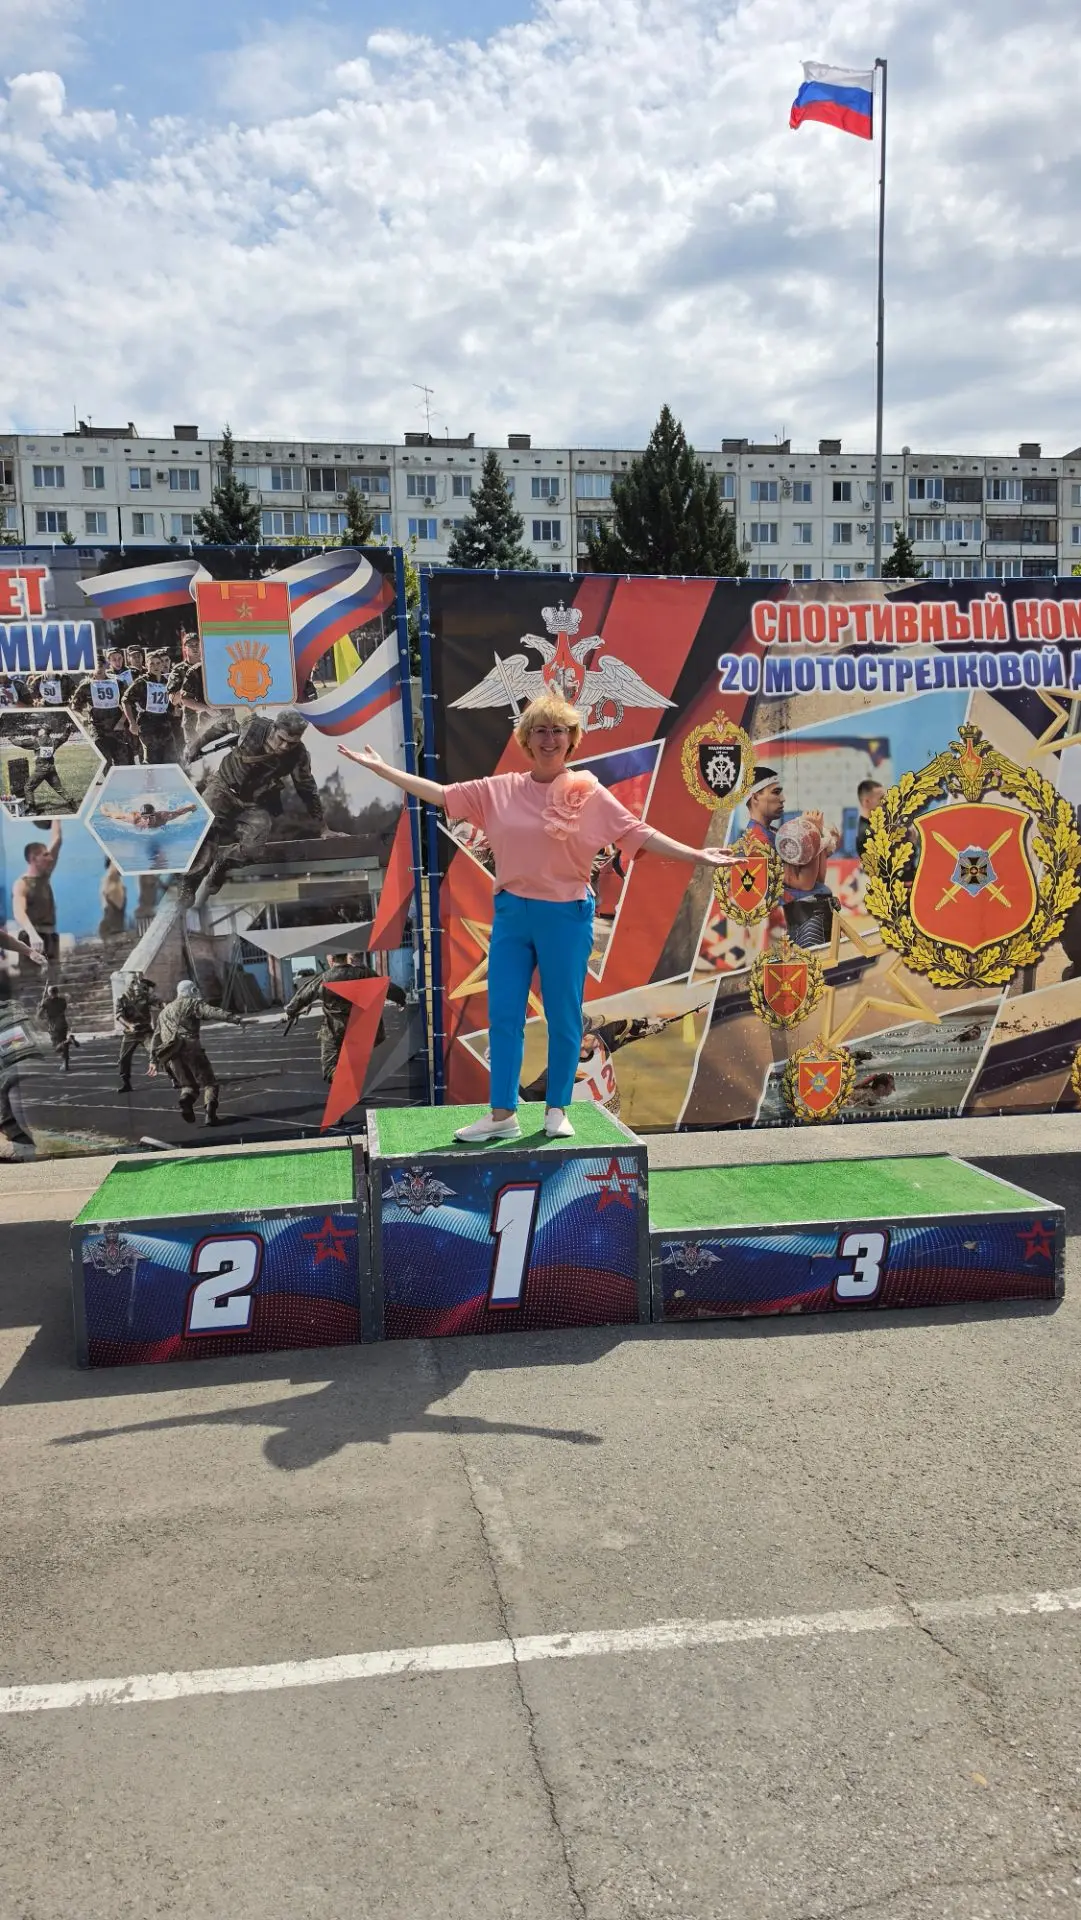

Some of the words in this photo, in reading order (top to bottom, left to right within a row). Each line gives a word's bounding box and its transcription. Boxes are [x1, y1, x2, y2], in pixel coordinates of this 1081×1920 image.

[753, 594, 1008, 644] СПОРТИВНЫЙ
[97, 687, 114, 700] 59
[720, 656, 759, 693] 20
[765, 648, 1063, 693] МОТОСТРЕЛКОВОЙ
[489, 1184, 538, 1308] 1
[835, 1231, 887, 1300] 3
[187, 1235, 260, 1335] 2
